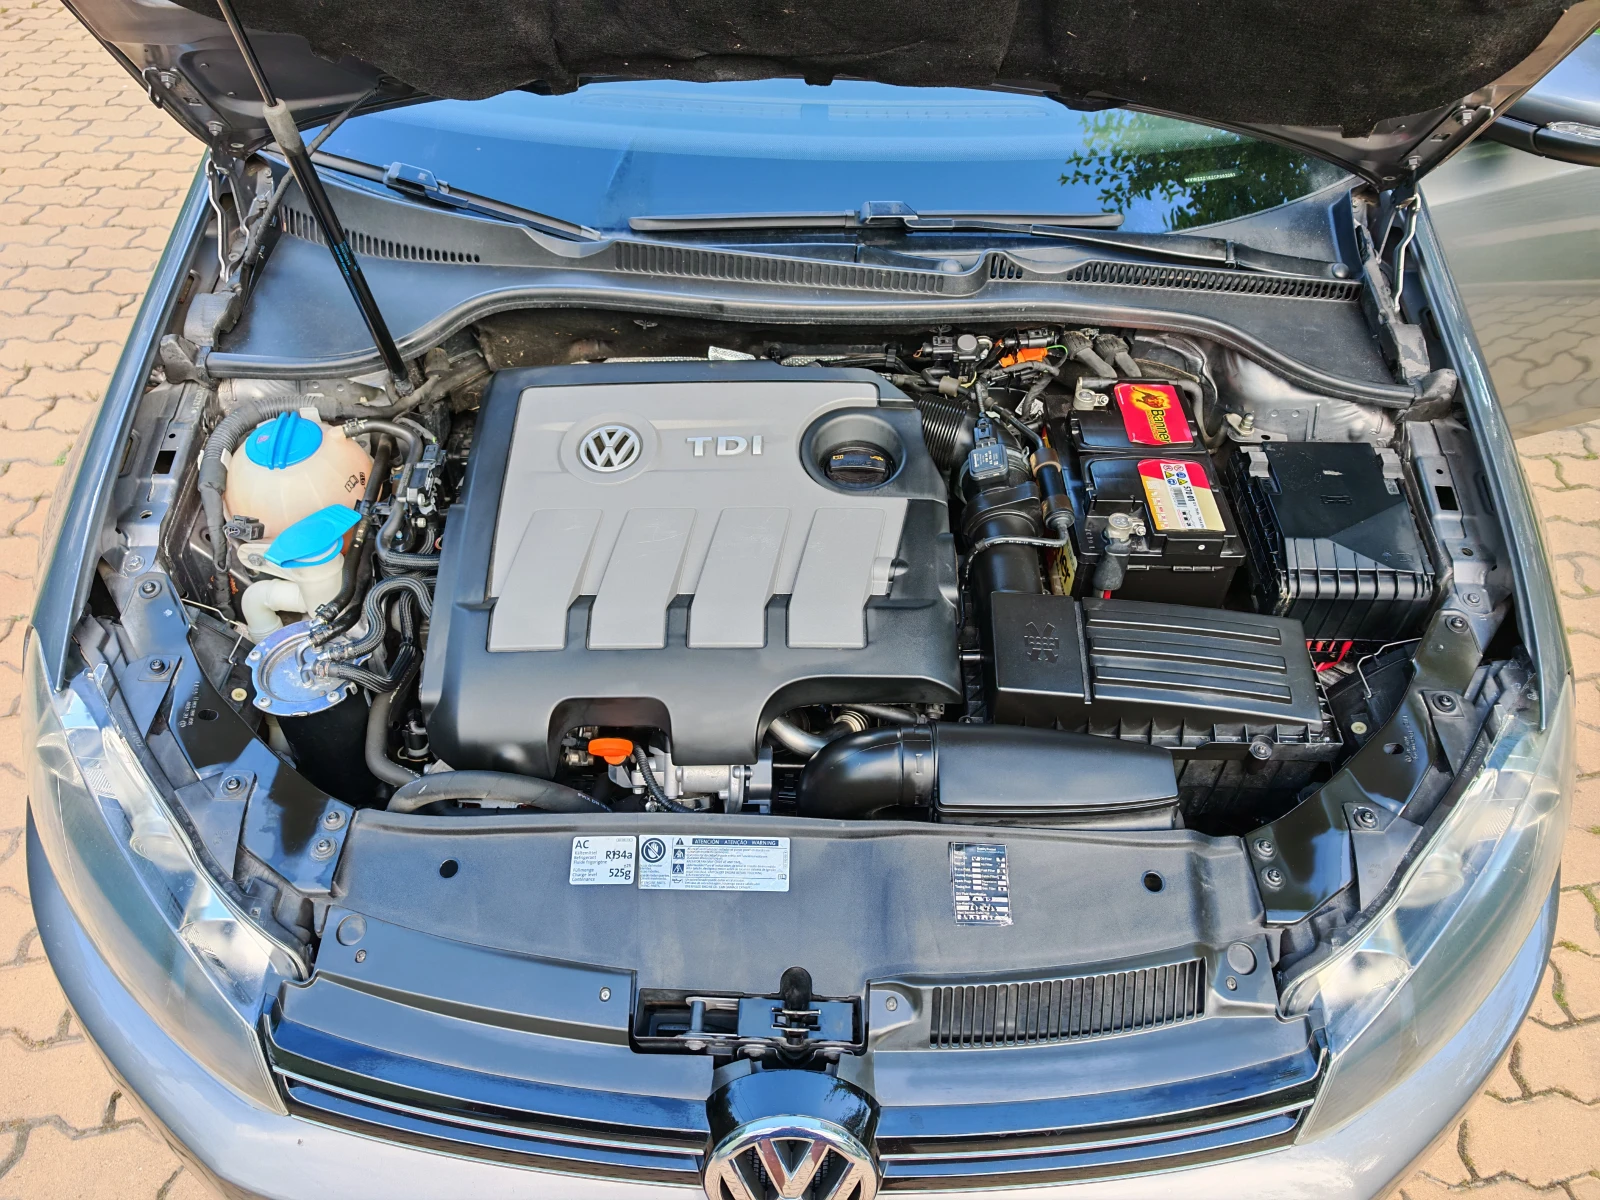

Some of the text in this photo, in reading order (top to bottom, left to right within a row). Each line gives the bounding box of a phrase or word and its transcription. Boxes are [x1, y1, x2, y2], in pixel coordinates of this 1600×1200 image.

[1150, 409, 1170, 443] Banner
[686, 435, 763, 457] TDI
[574, 839, 590, 849] AC
[605, 850, 633, 861] R134a
[609, 868, 631, 880] 525g
